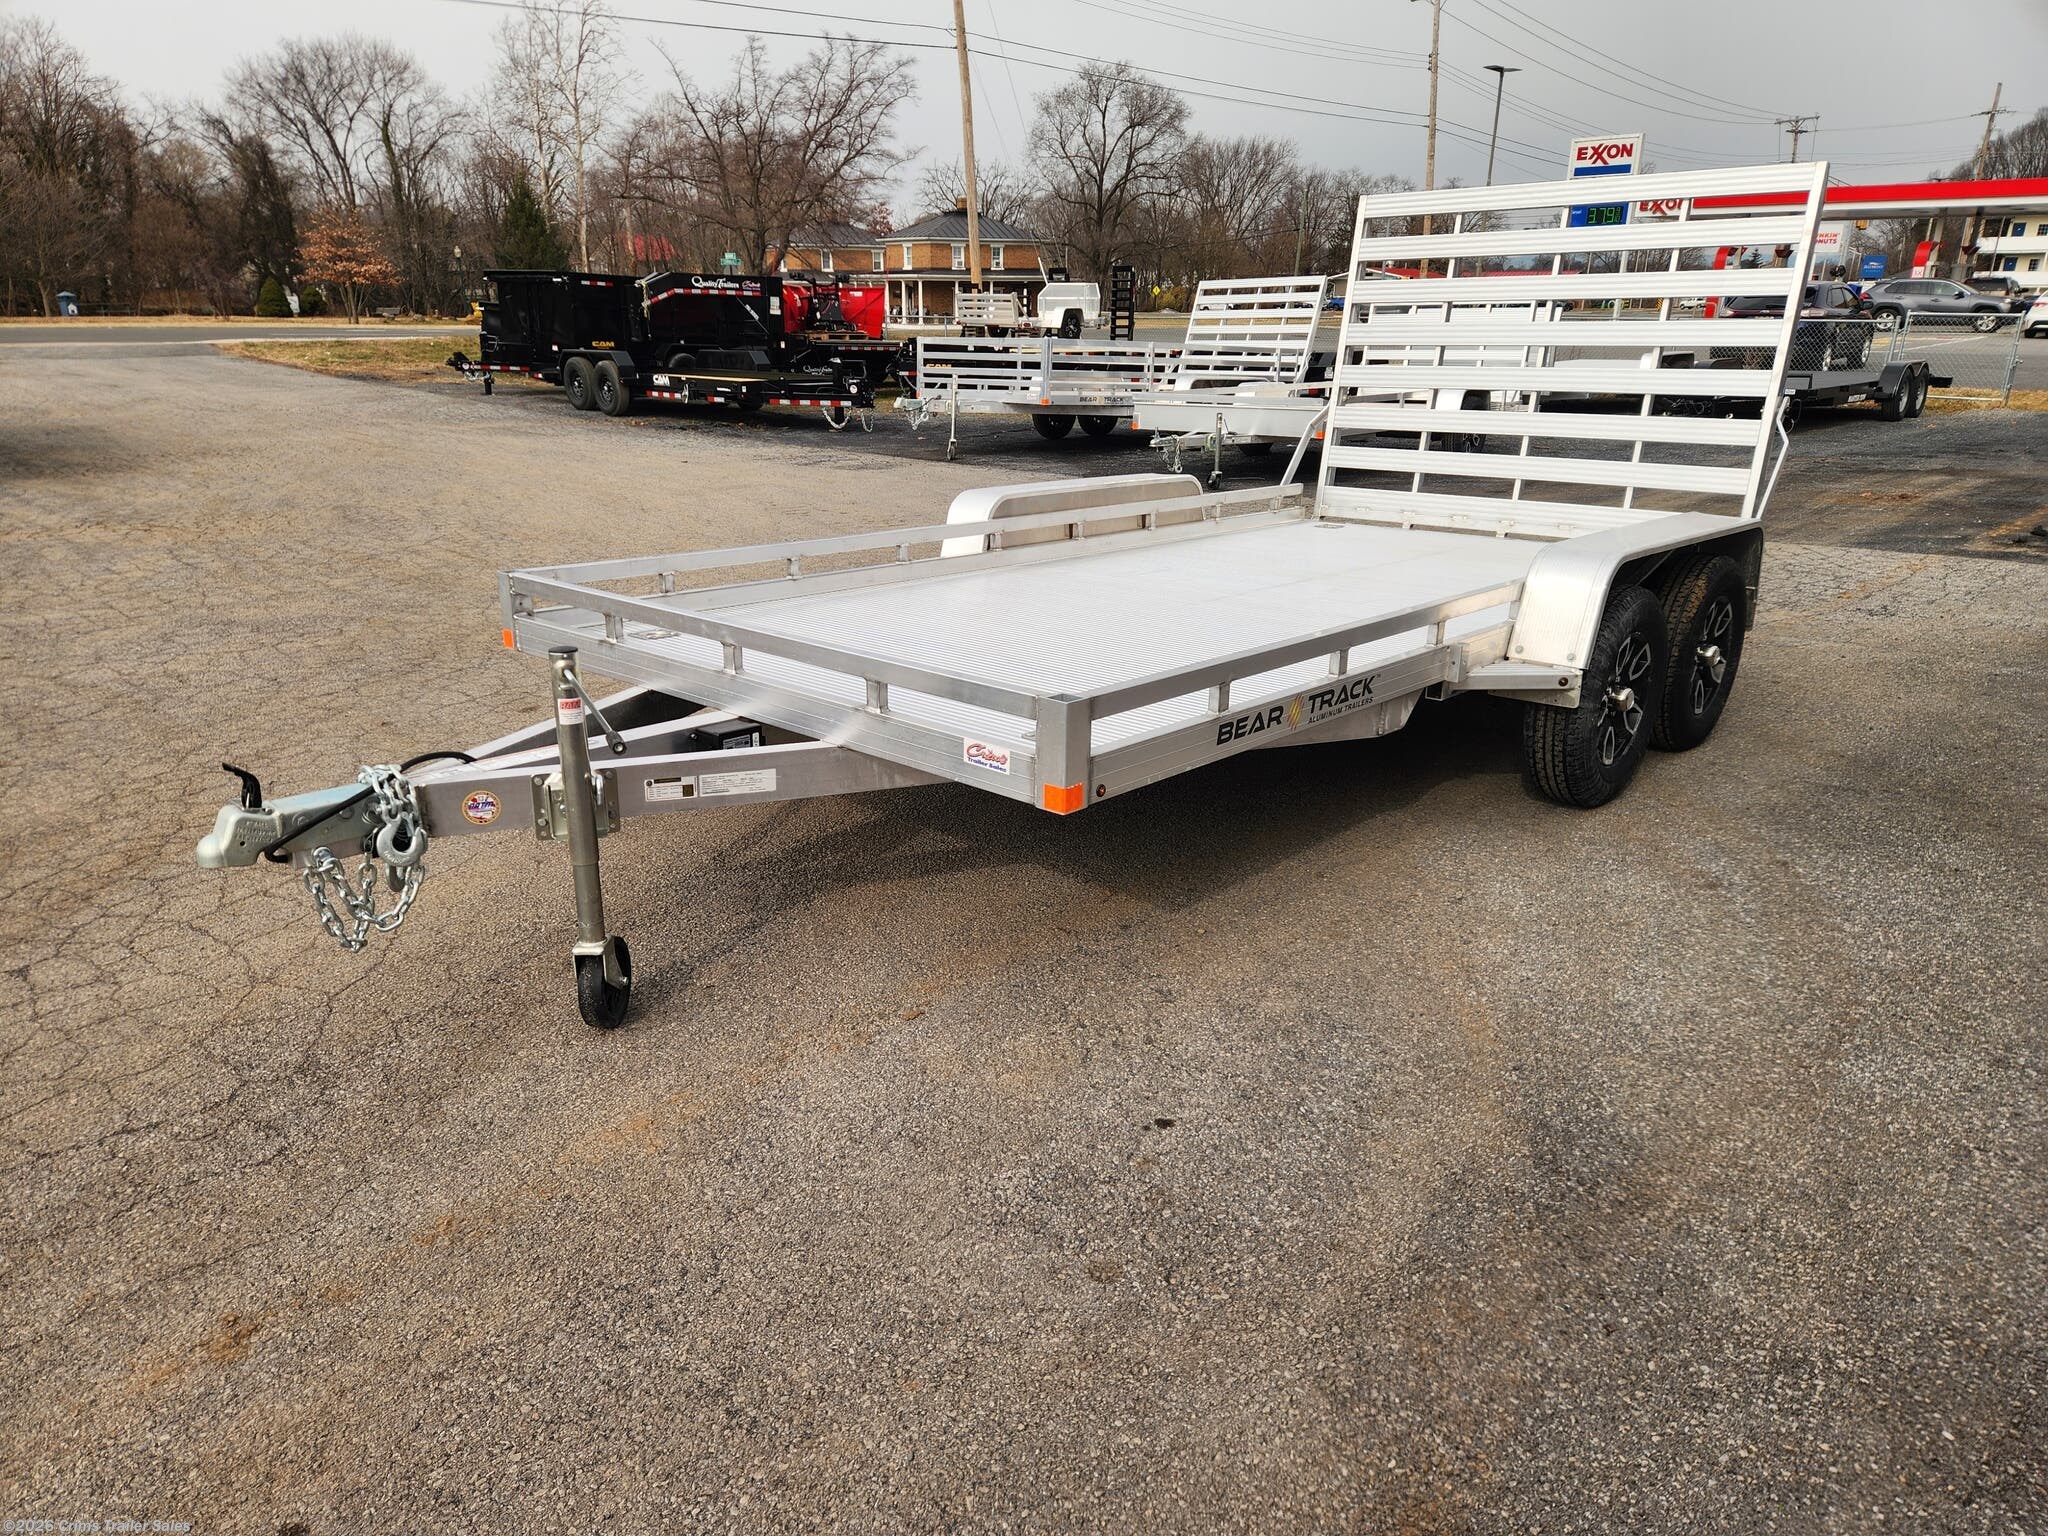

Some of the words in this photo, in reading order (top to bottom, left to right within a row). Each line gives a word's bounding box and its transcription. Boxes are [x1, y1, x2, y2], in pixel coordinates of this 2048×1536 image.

[1576, 143, 1633, 165] EXXON
[652, 374, 670, 386] CAM
[1216, 705, 1284, 745] BEAR
[1308, 675, 1376, 714] TRACK
[1307, 706, 1343, 725] ALUMINUM
[1344, 696, 1374, 713] TRAILERS
